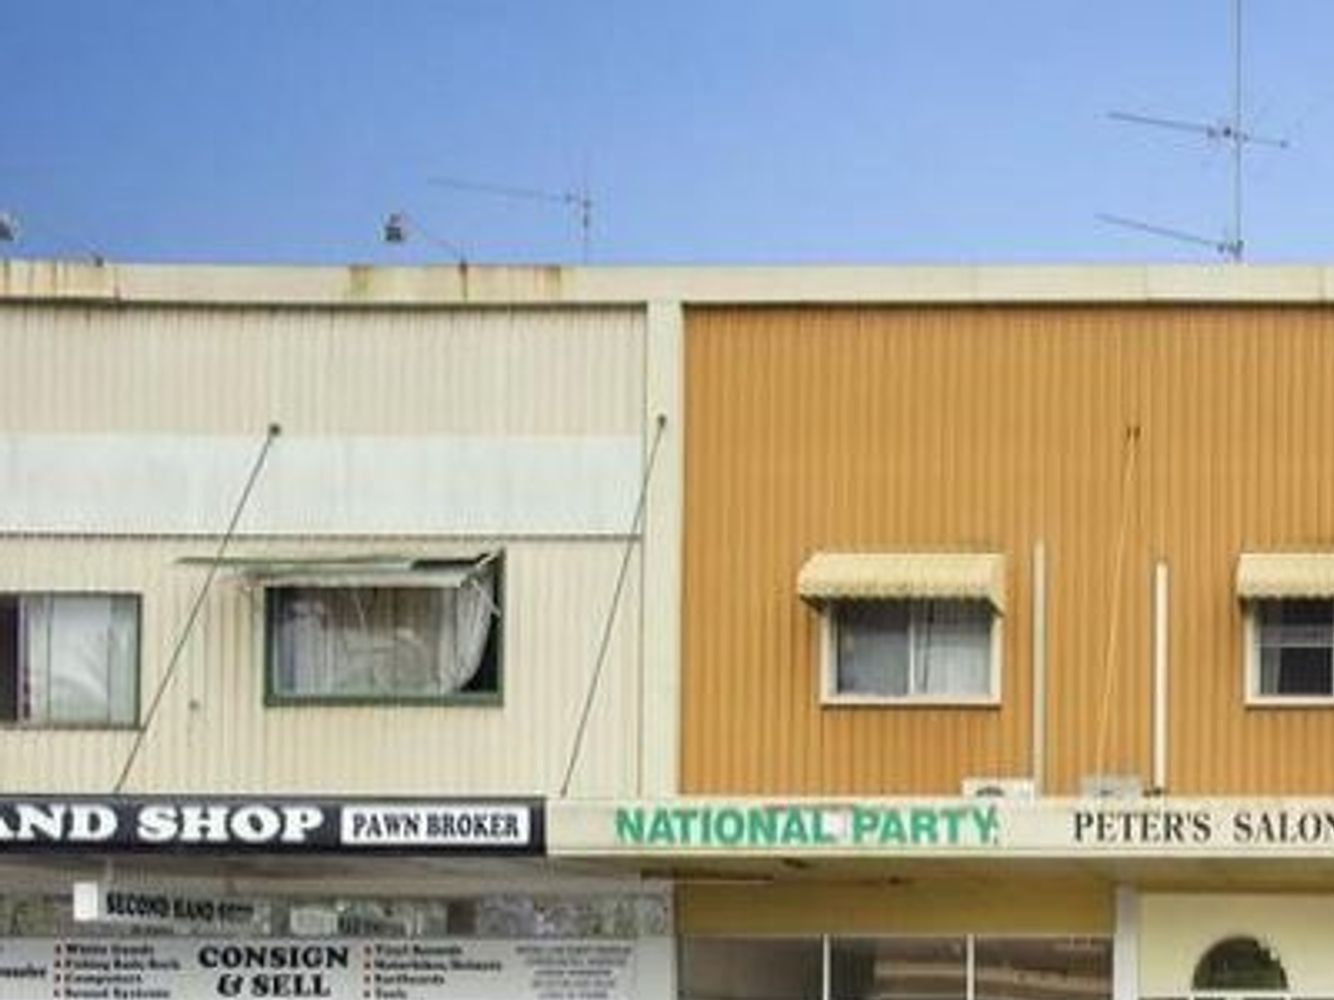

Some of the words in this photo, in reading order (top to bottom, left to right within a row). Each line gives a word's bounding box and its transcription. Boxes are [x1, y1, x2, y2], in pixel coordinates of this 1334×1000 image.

[137, 803, 324, 843] SHOP
[351, 812, 421, 838] PAWN
[426, 812, 520, 838] BROKER
[615, 804, 836, 844] NATIONAL
[1074, 811, 1212, 842] PETER'S
[198, 945, 350, 969] CONSIGN
[251, 973, 331, 997] SELL
